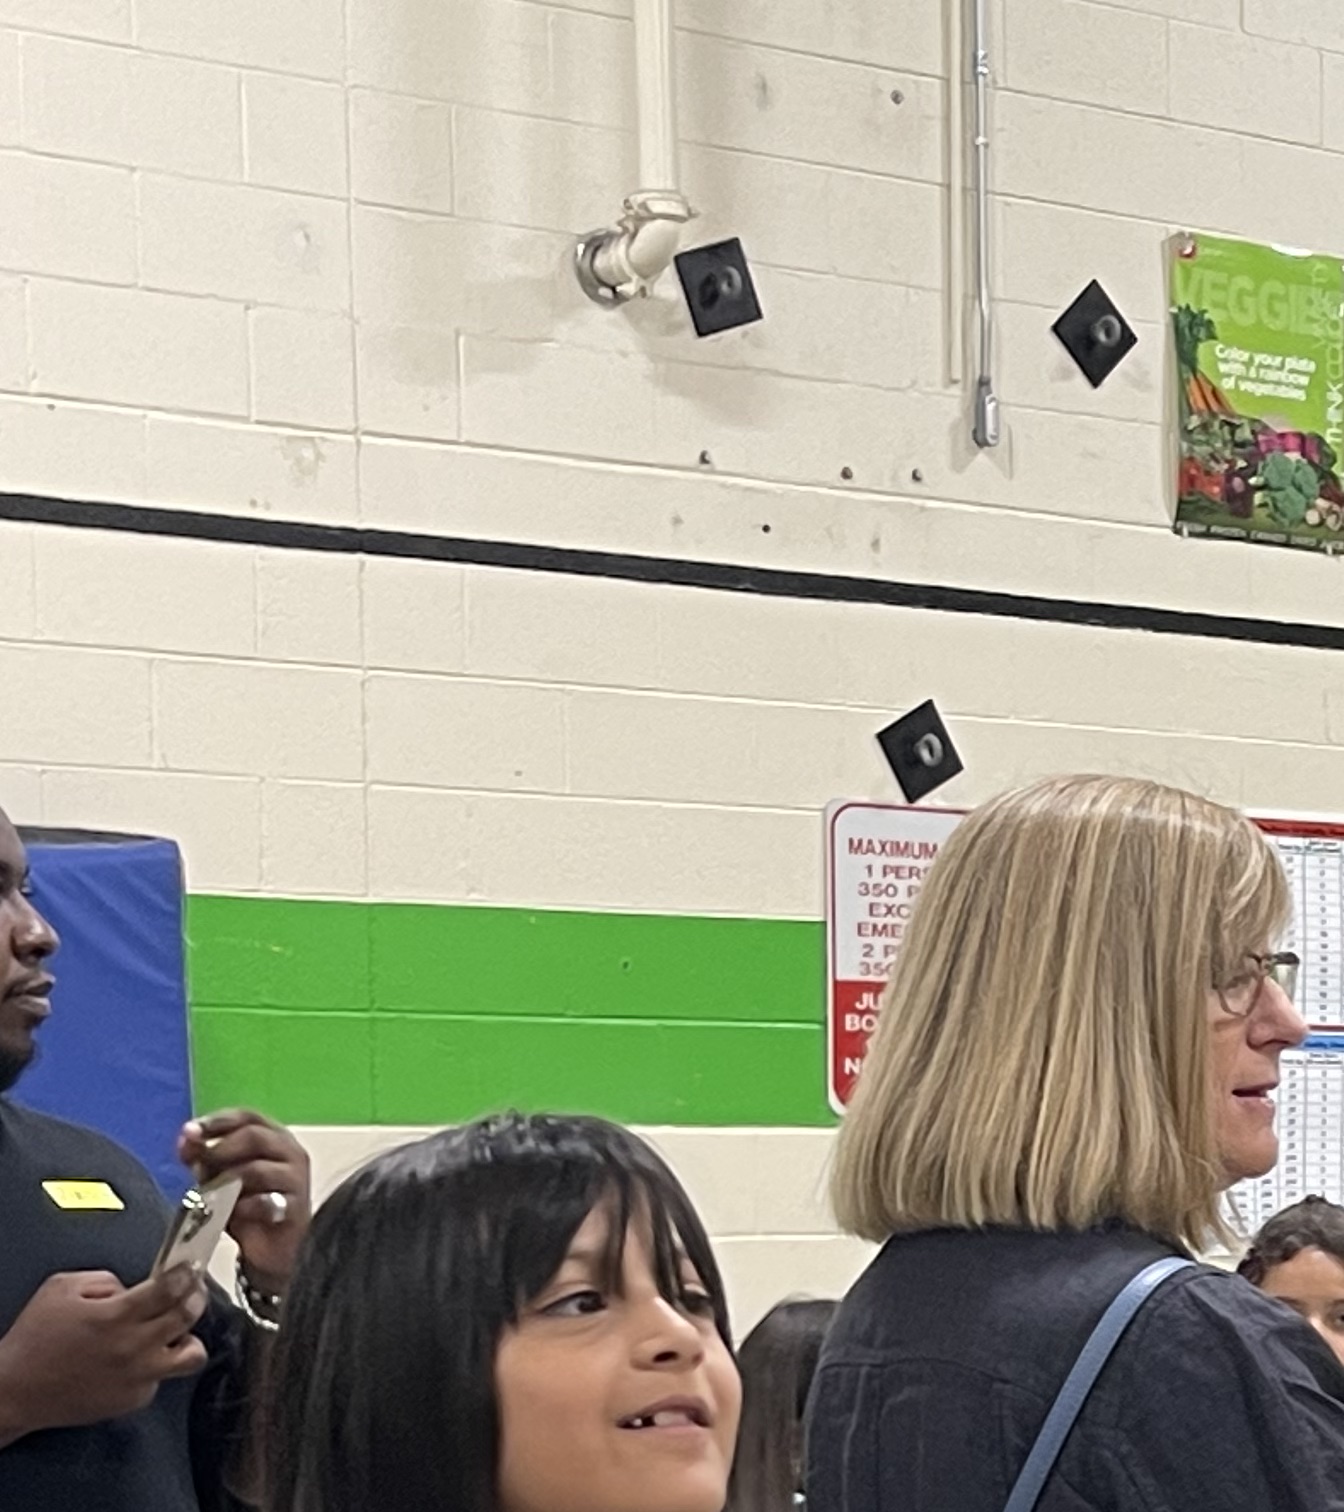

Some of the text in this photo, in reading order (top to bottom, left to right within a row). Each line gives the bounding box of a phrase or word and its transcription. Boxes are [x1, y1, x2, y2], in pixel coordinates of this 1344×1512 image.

[1238, 381, 1306, 401] vegetables
[1325, 382, 1344, 443] THINK
[865, 864, 873, 878] 1
[858, 882, 898, 898] 350
[862, 944, 874, 958] 2
